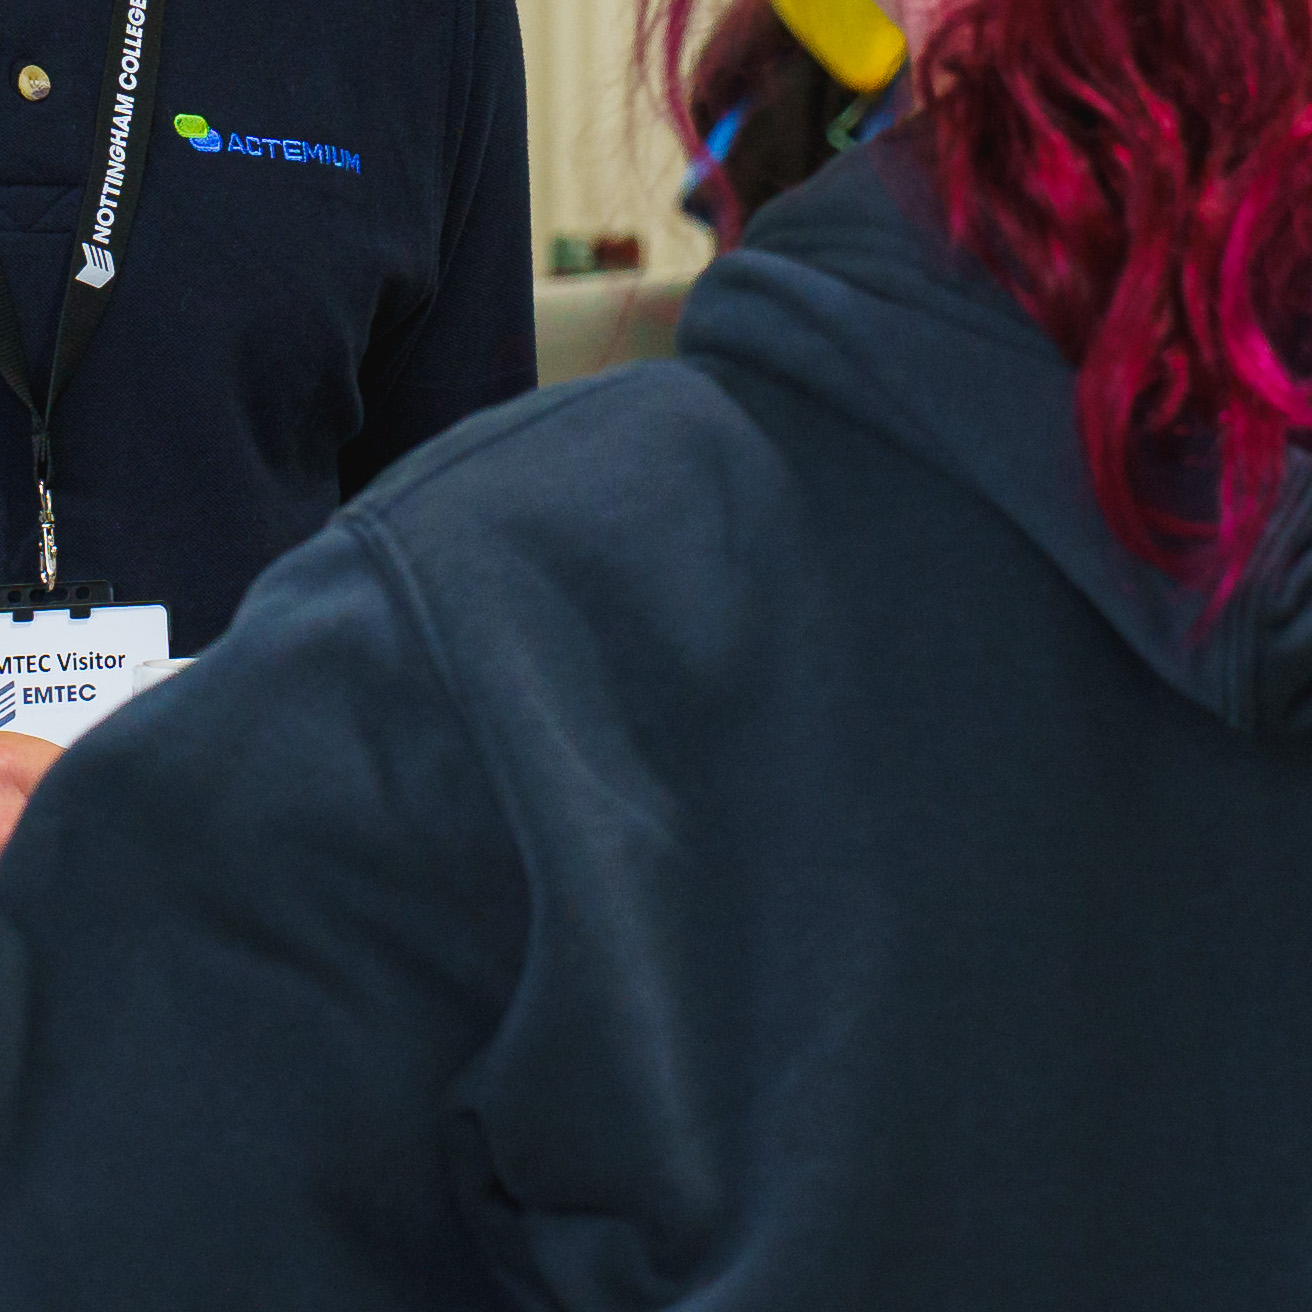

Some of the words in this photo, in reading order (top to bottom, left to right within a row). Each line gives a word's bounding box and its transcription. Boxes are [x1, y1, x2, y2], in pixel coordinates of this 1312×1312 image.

[92, 92, 135, 245] NOTTINGHAM
[227, 132, 361, 174] ACTEMIUM
[56, 651, 126, 672] Visitor
[23, 683, 97, 705] EMTEC
